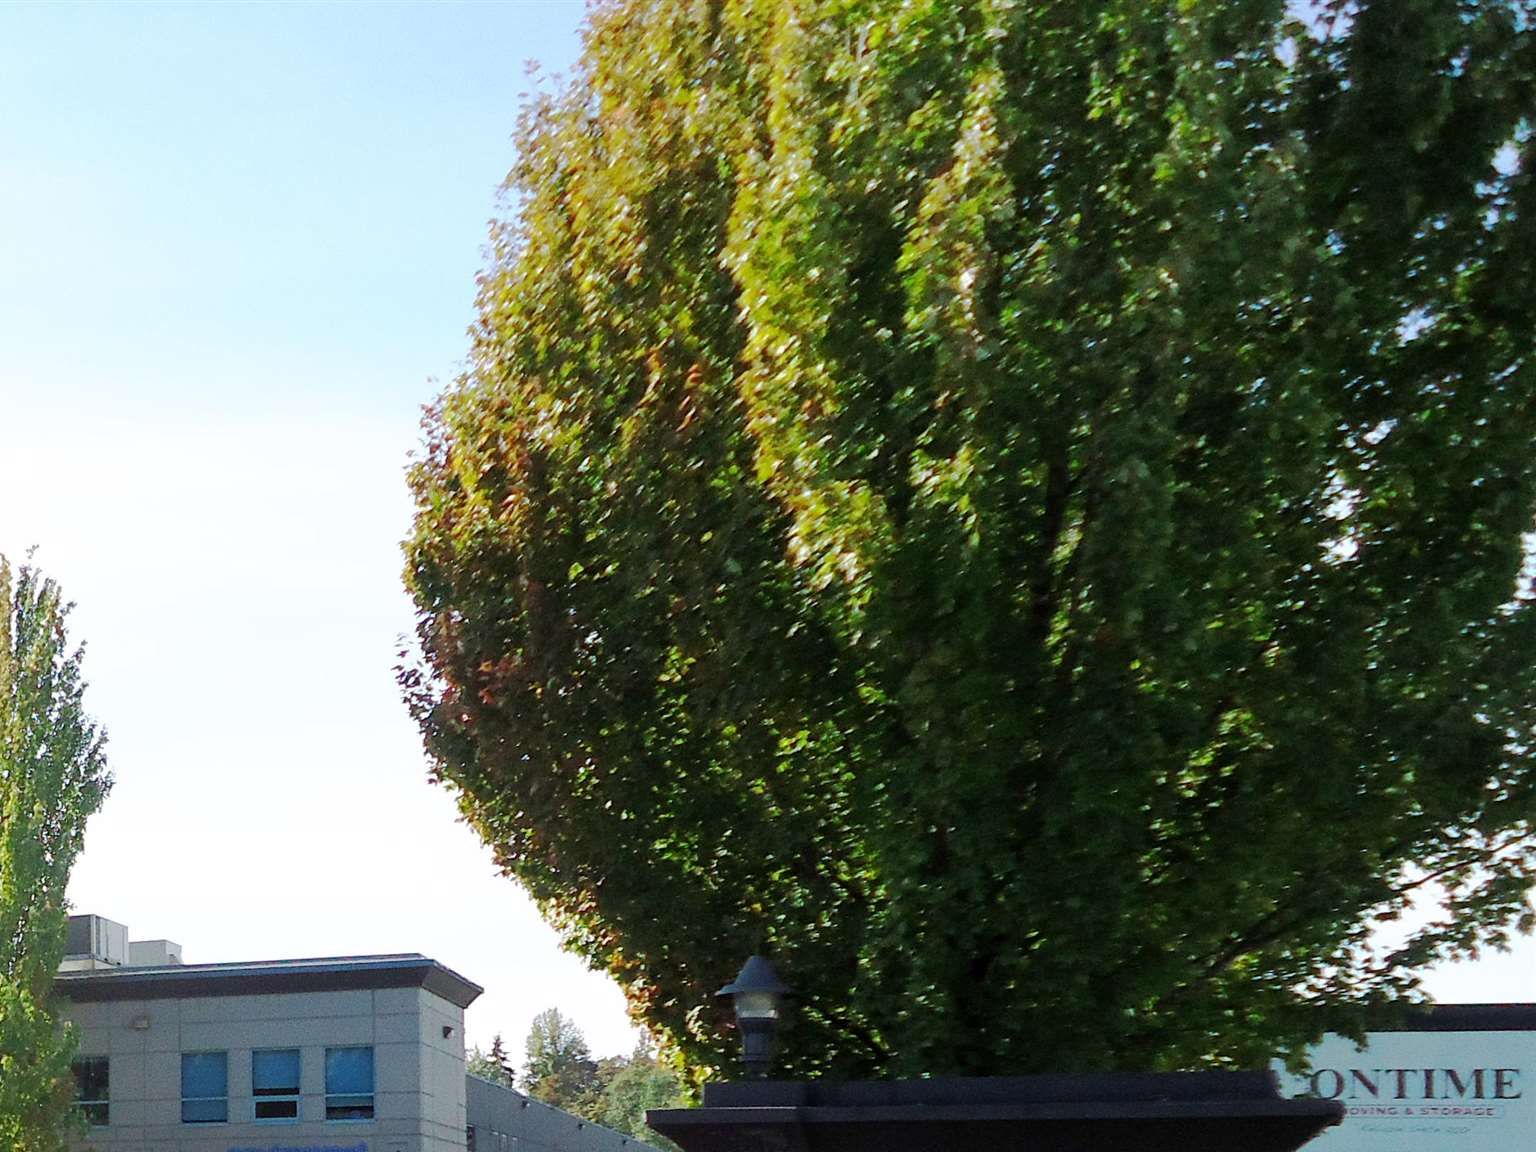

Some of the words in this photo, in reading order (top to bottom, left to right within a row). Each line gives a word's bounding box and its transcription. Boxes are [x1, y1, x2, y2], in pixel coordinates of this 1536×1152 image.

[1311, 1068, 1522, 1100] ONTIME
[1344, 1106, 1398, 1116] OVING
[1420, 1106, 1496, 1117] STORAGE
